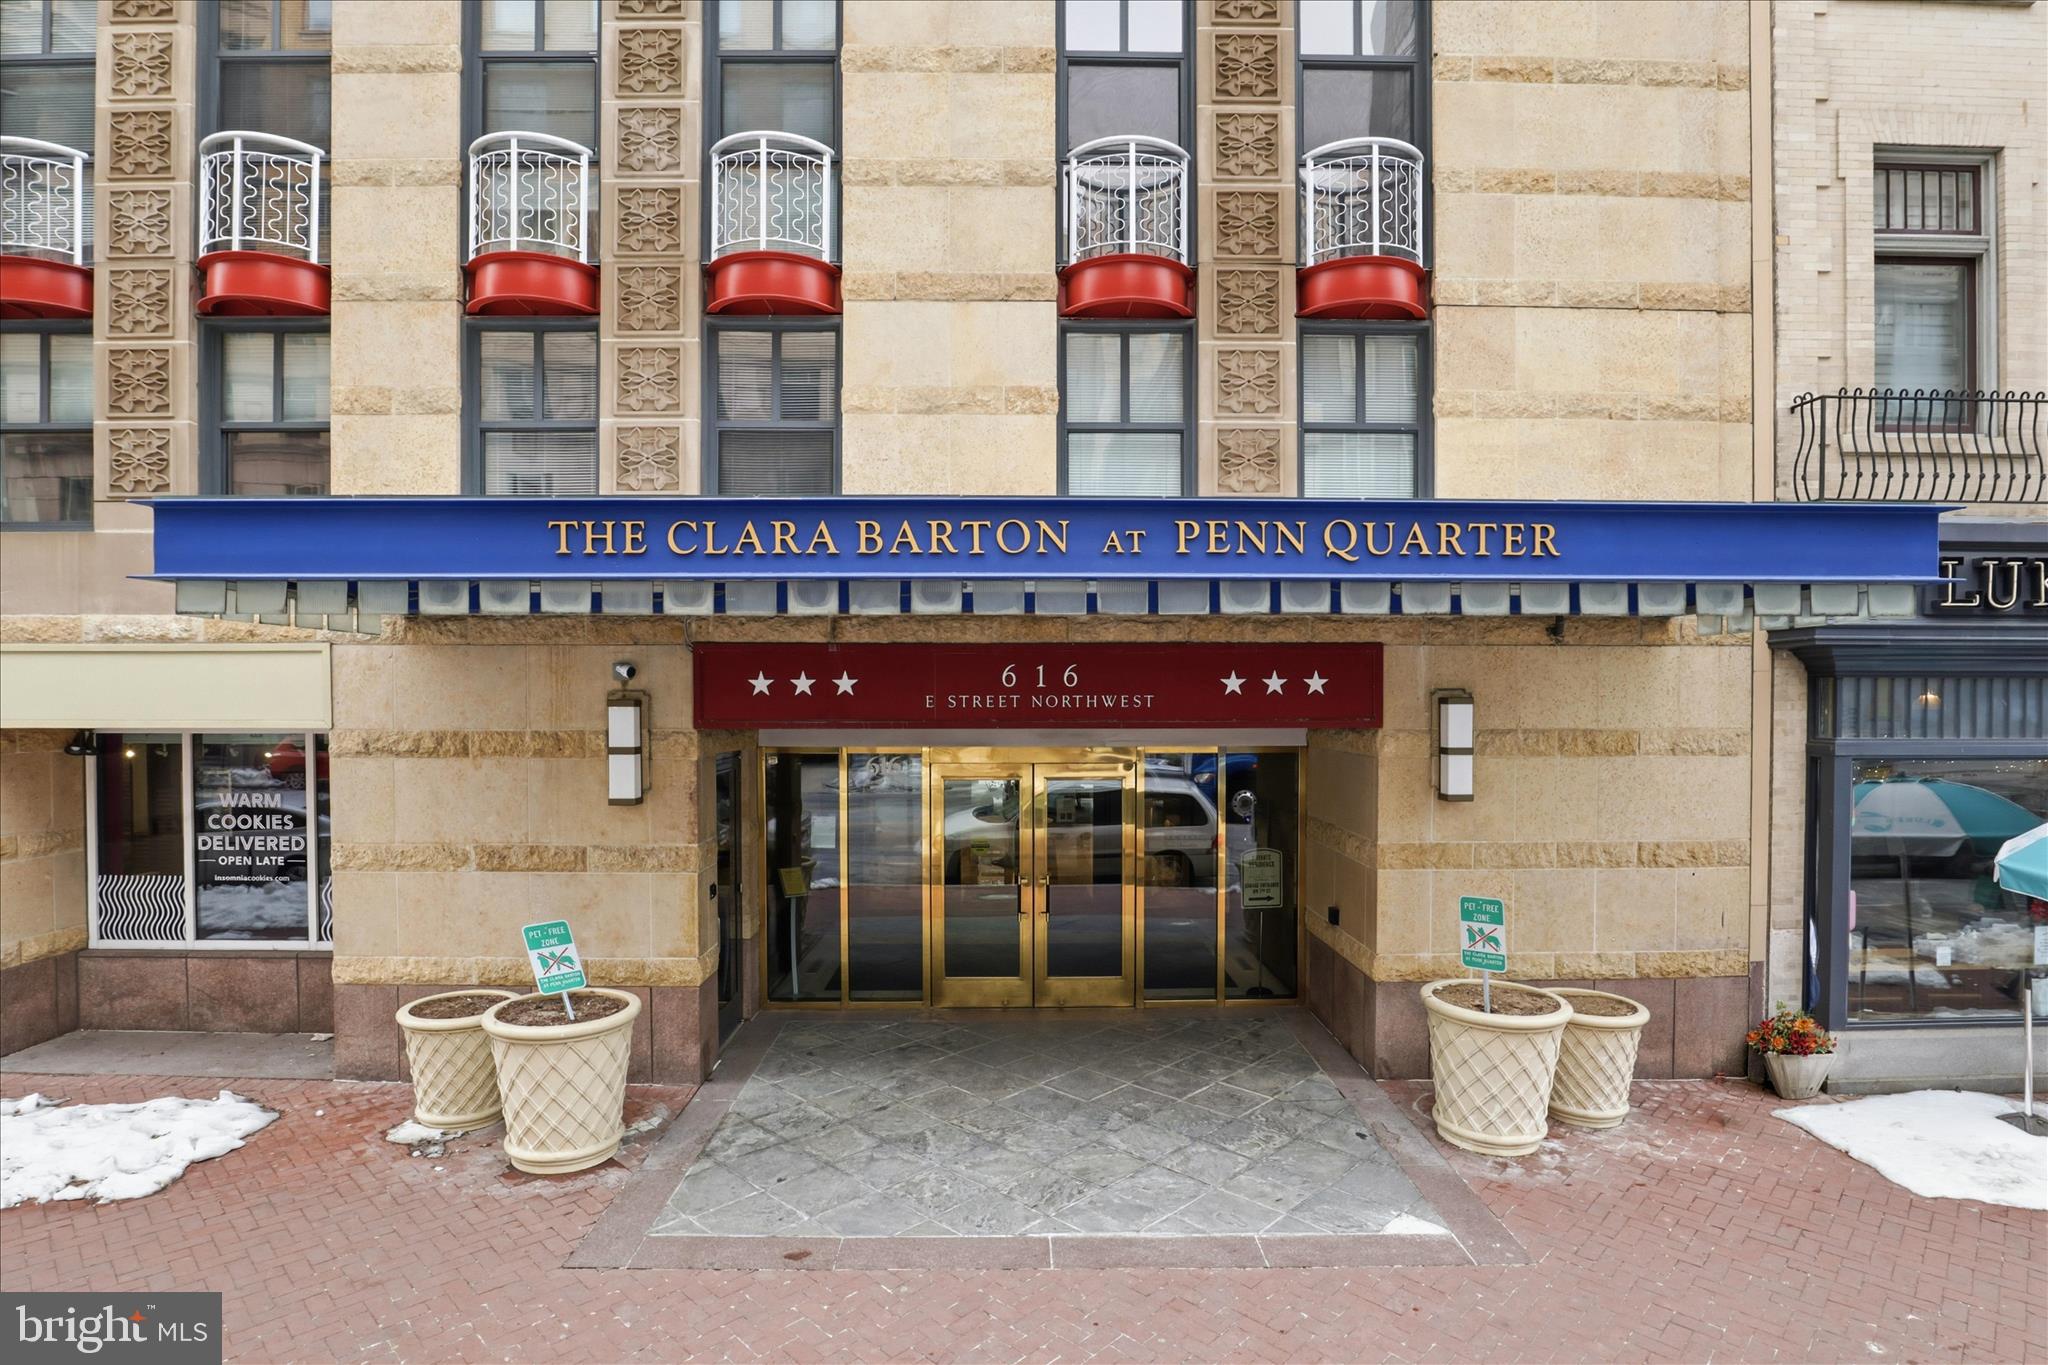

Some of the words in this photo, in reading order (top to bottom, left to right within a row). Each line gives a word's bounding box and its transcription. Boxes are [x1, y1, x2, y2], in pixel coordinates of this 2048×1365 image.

[547, 519, 648, 555] THE
[666, 519, 840, 555] CLARA
[855, 519, 1069, 556] BARTON
[1101, 530, 1147, 554] AT
[1174, 519, 1307, 556] PENN
[1322, 518, 1561, 563] QUARTER
[1001, 663, 1078, 688] 616
[925, 695, 936, 708] E
[947, 694, 1021, 709] STREET
[1031, 694, 1155, 709] NORTHWEST
[218, 792, 281, 809] WARM
[207, 813, 295, 830] COOKIES
[197, 835, 306, 851] DELIVERED
[217, 855, 252, 866] OPEN
[255, 855, 285, 866] LATE
[1464, 902, 1476, 911] PET
[1482, 903, 1499, 913] FREE
[1473, 913, 1491, 922] ZONE
[529, 930, 542, 939] PET
[548, 926, 566, 936] FREE
[541, 937, 560, 947] ZONE
